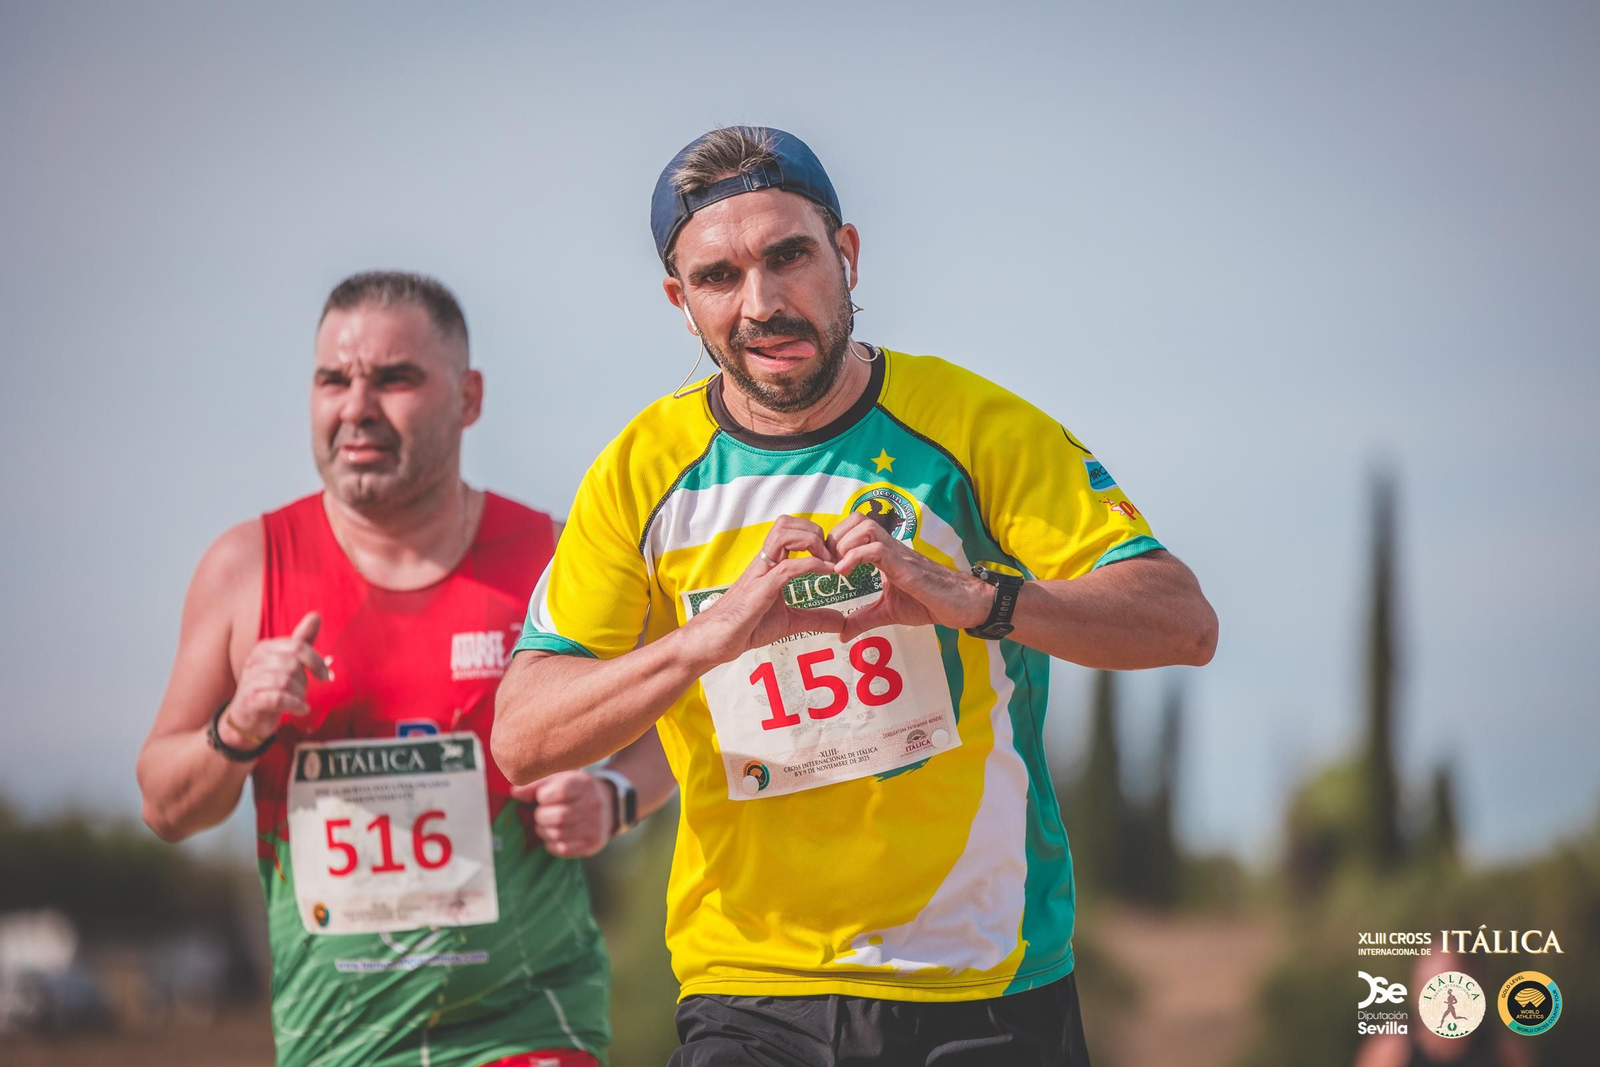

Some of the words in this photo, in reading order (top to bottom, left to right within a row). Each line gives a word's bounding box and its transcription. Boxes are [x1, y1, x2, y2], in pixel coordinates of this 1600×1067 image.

[903, 502, 917, 533] Agility
[785, 573, 856, 606] LICA
[826, 591, 857, 604] COUNTRY
[749, 636, 903, 731] 158
[328, 747, 427, 776] ITÁLICA
[783, 764, 802, 773] CROSS
[802, 755, 847, 769] INTERNACIONAL
[816, 761, 849, 772] NOVIEMBRE
[858, 755, 870, 763] 2025
[325, 809, 453, 878] 516
